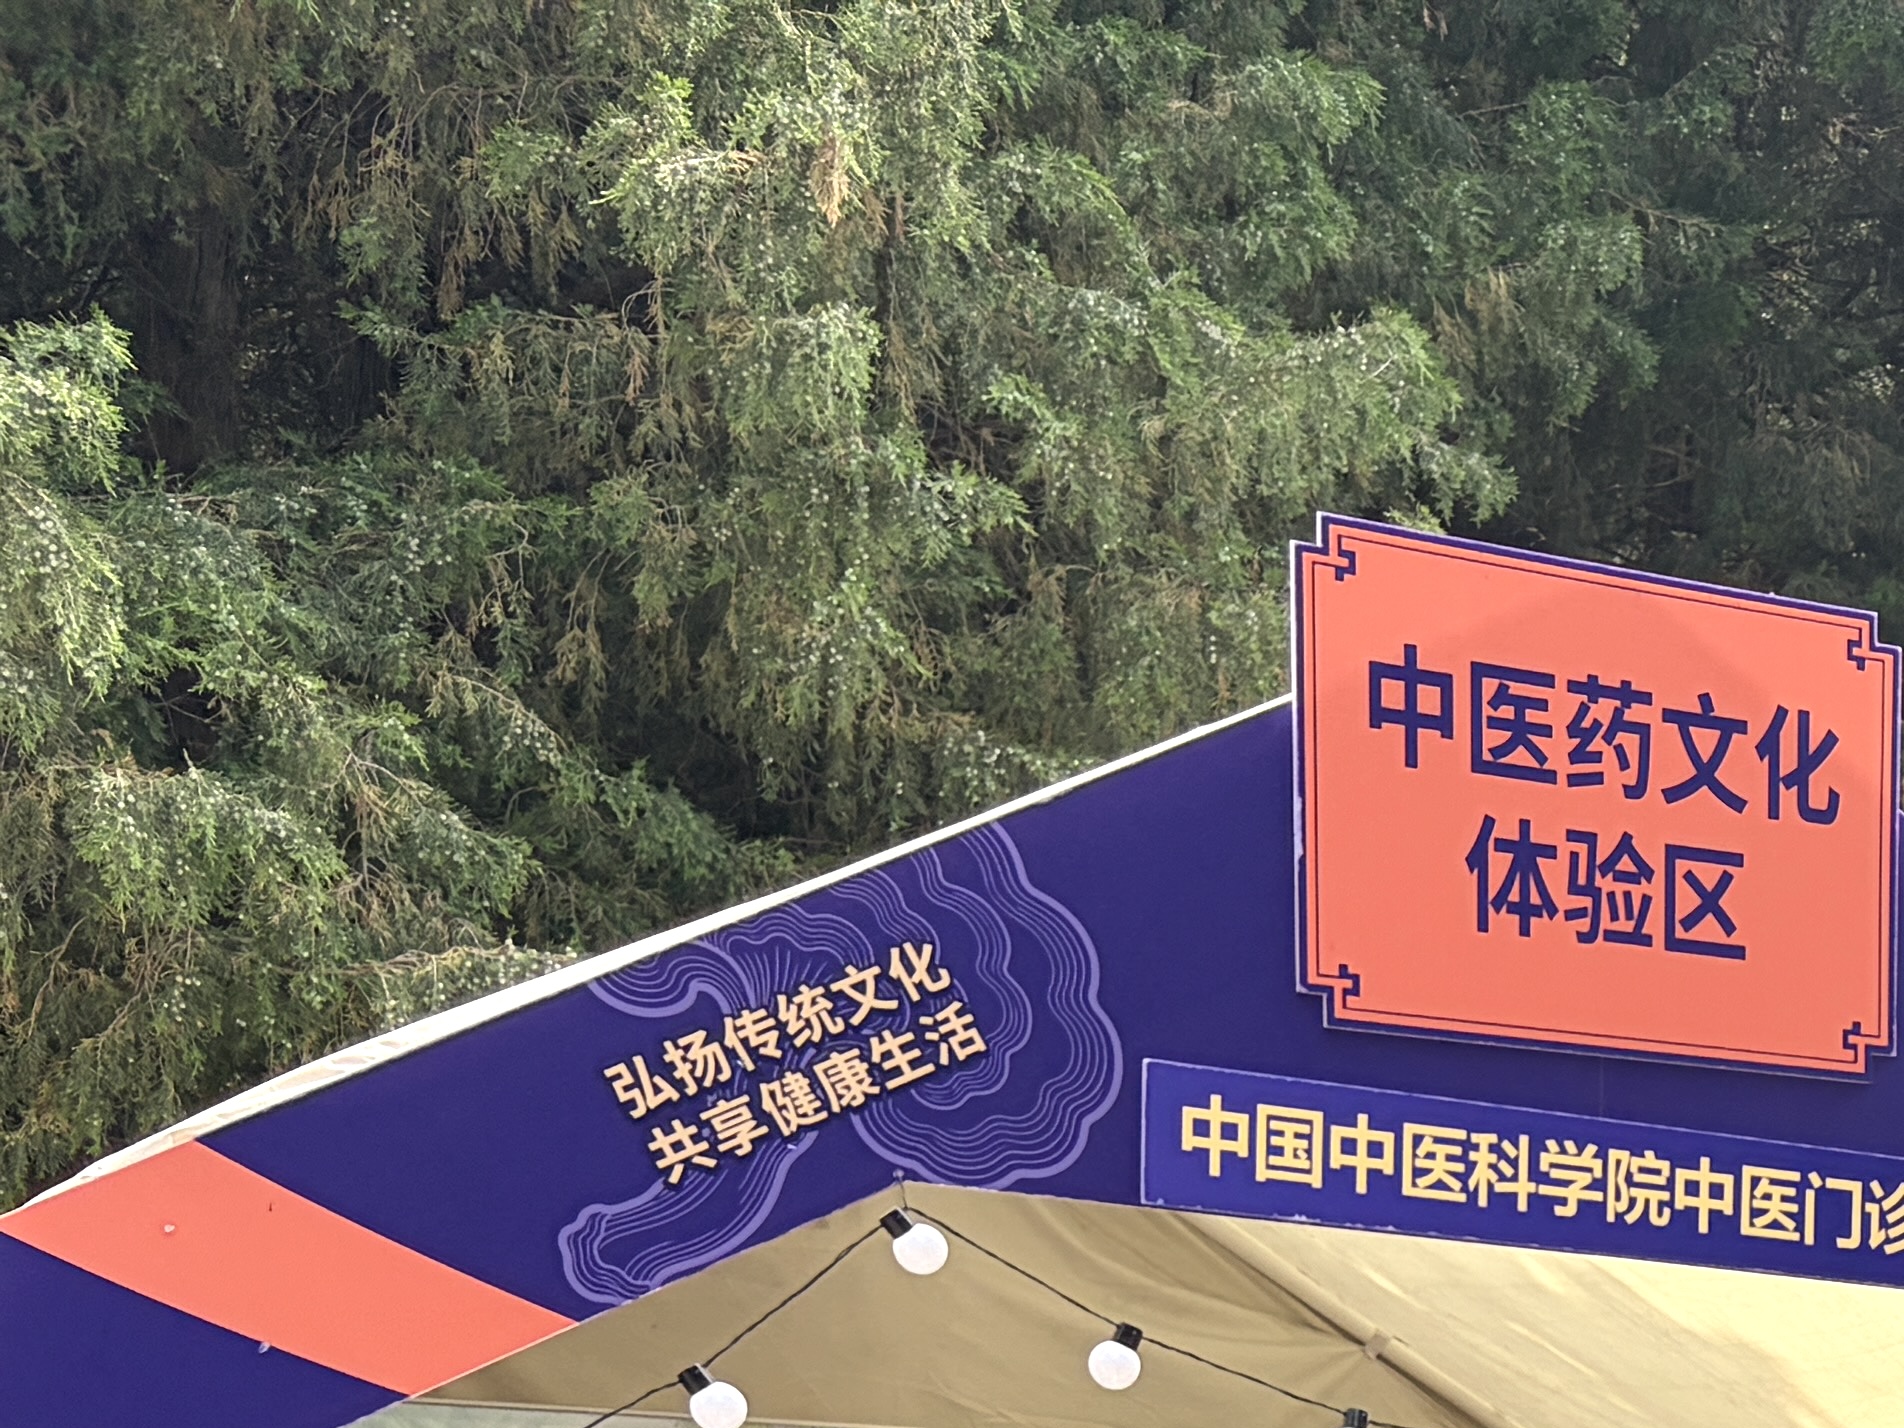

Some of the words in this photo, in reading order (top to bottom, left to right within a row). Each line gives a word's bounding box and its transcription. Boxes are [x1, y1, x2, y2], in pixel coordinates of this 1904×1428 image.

[1366, 642, 1841, 826] 中医药文化
[1465, 814, 1748, 961] 体验区
[603, 940, 953, 1119] 弘扬传统文化
[646, 1000, 988, 1186] 共享健康生活
